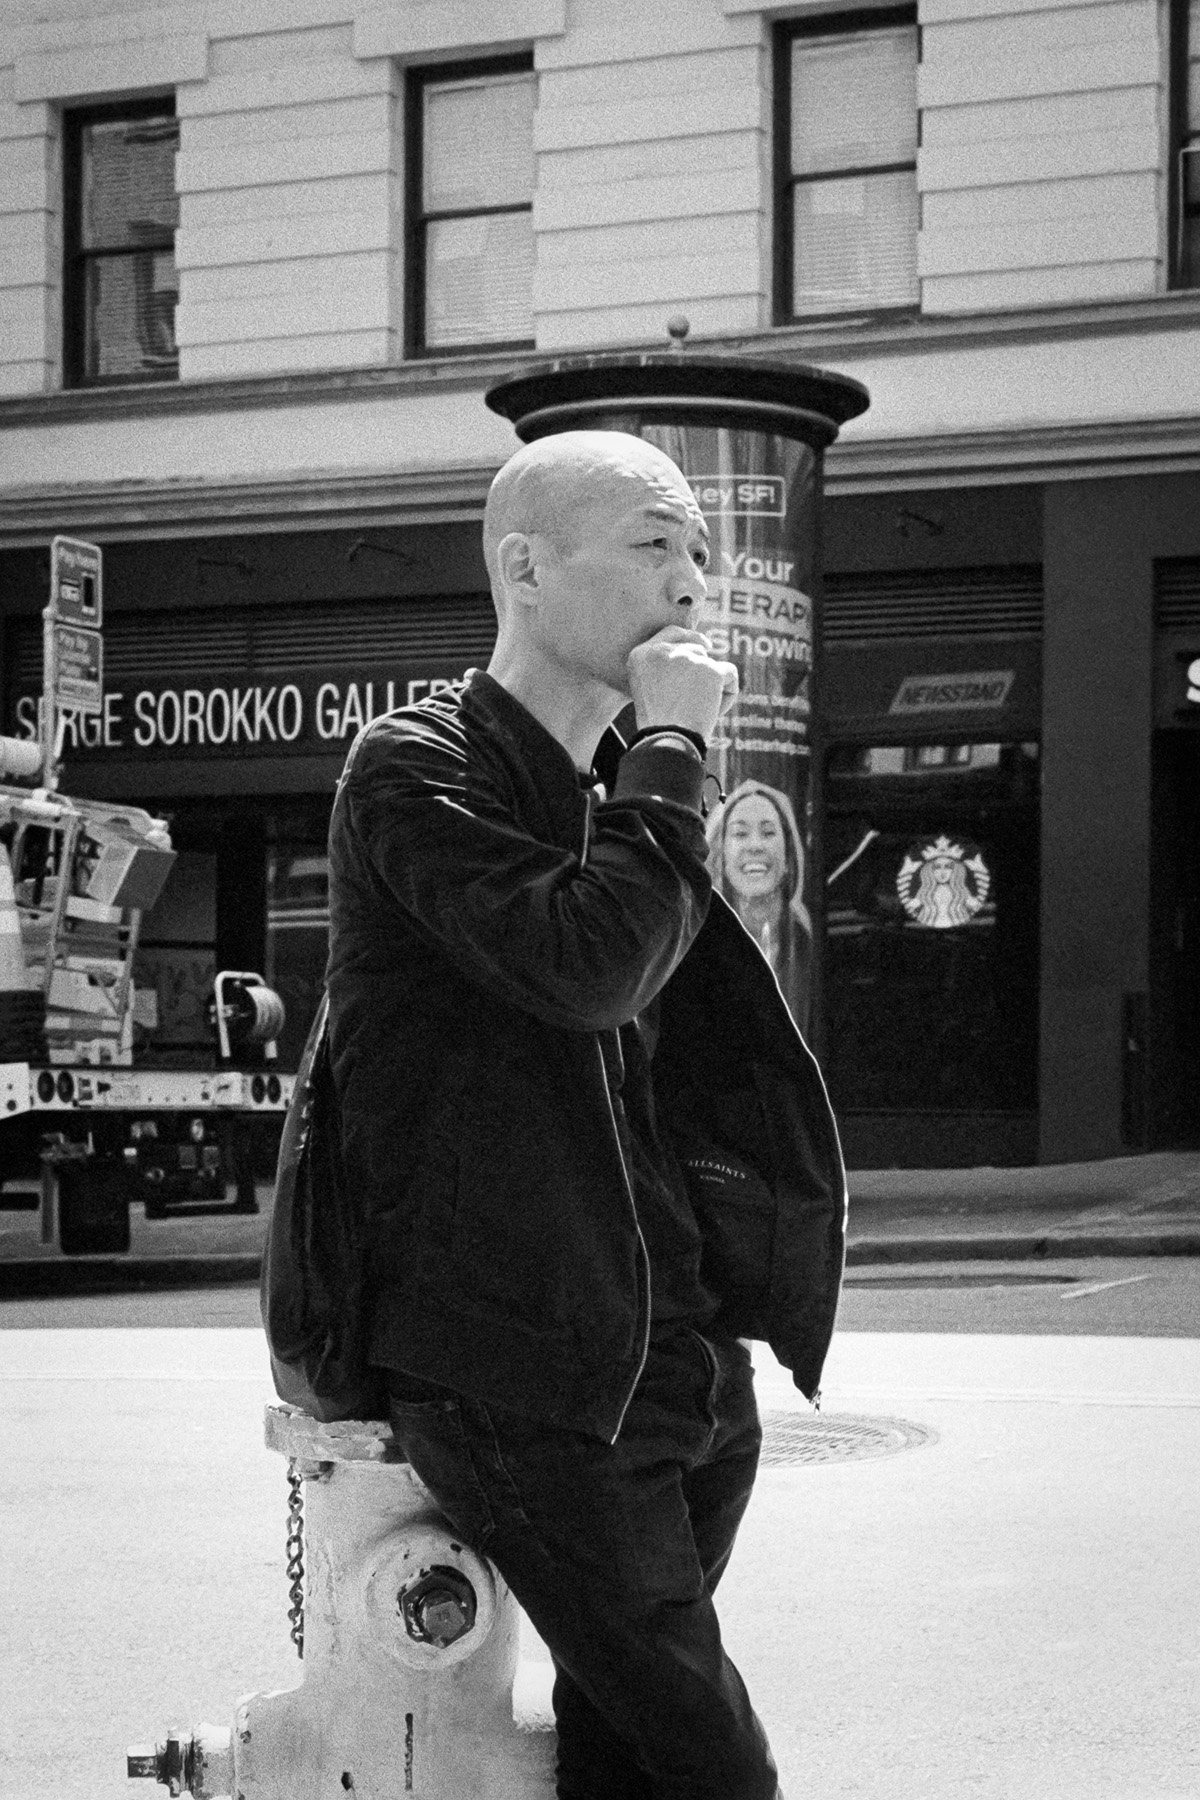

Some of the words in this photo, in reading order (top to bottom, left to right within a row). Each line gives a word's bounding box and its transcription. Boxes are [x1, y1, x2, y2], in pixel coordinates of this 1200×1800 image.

[721, 551, 795, 582] Your
[704, 590, 810, 623] HERAP
[134, 684, 303, 747] SOROKKO
[315, 677, 459, 740] GALL
